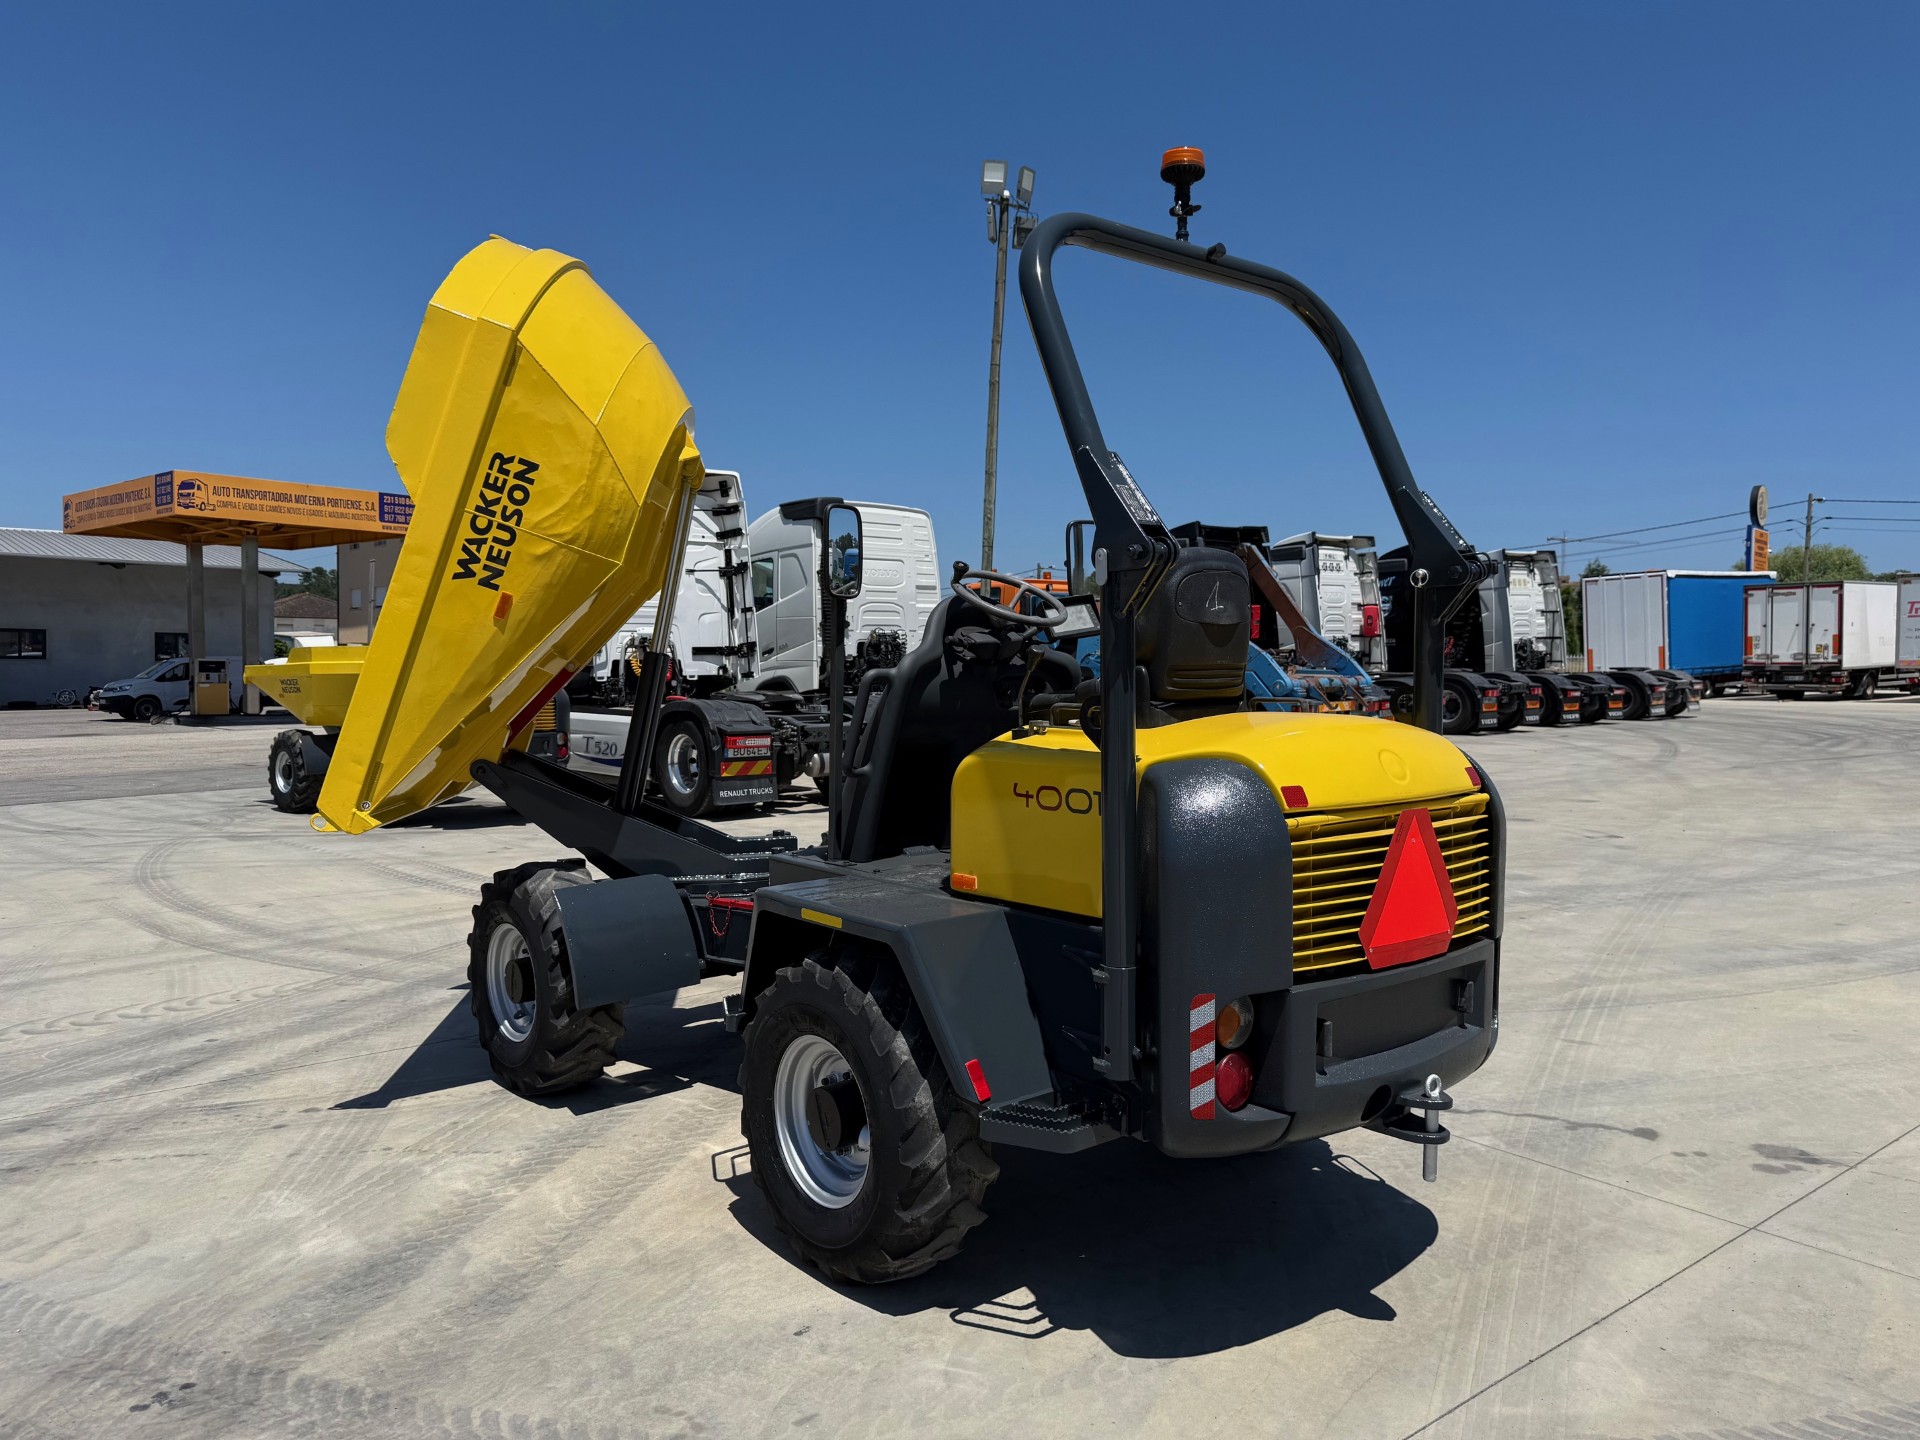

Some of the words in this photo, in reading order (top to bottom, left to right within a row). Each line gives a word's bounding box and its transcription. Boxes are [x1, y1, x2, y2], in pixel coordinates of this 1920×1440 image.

[212, 486, 230, 498] AUTO
[232, 487, 293, 504] TRANSPORTADORA
[365, 501, 377, 512] S.A.
[216, 500, 237, 509] COMPRA
[242, 502, 258, 511] VENDA
[451, 451, 517, 581] WACKER
[477, 456, 541, 592] NEUSON
[864, 568, 900, 578] VOLVO
[720, 789, 748, 798] RENAULT
[749, 787, 773, 795] TRUCKS
